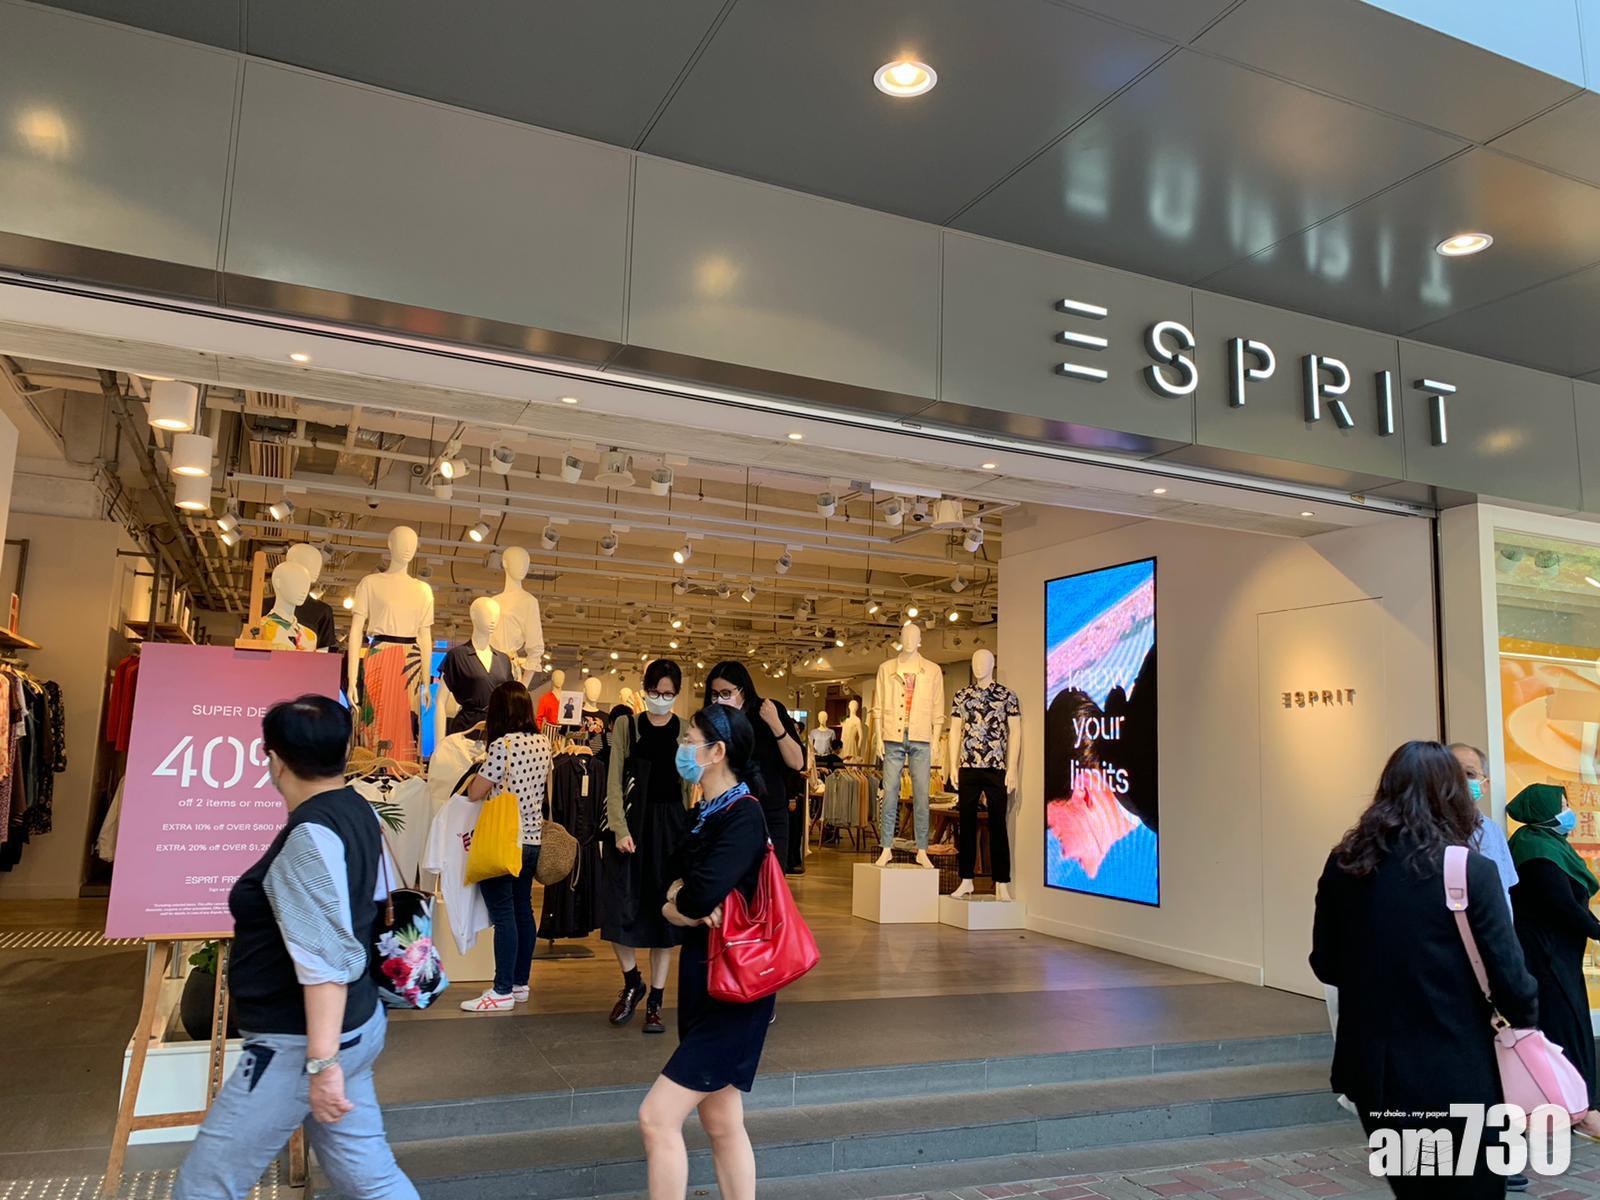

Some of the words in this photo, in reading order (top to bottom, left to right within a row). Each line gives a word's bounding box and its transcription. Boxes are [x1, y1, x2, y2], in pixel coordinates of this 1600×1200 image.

[1056, 298, 1456, 446] ESPRIT
[1281, 688, 1356, 708] ESPRIT
[192, 704, 242, 716] SUPER
[1072, 716, 1125, 749] your
[1070, 759, 1129, 794] limits
[178, 798, 193, 808] off
[196, 798, 203, 808] 2
[206, 799, 236, 808] items
[239, 800, 251, 808] or
[254, 800, 282, 808] more
[162, 823, 192, 831] EXTRA
[195, 823, 211, 831] 10%
[213, 823, 224, 831] off
[226, 823, 251, 831] OVER
[156, 843, 186, 852] EXTRA
[188, 843, 207, 852] 20%
[209, 843, 220, 851] off
[222, 843, 247, 851] OVER
[185, 875, 219, 885] ESPRIT
